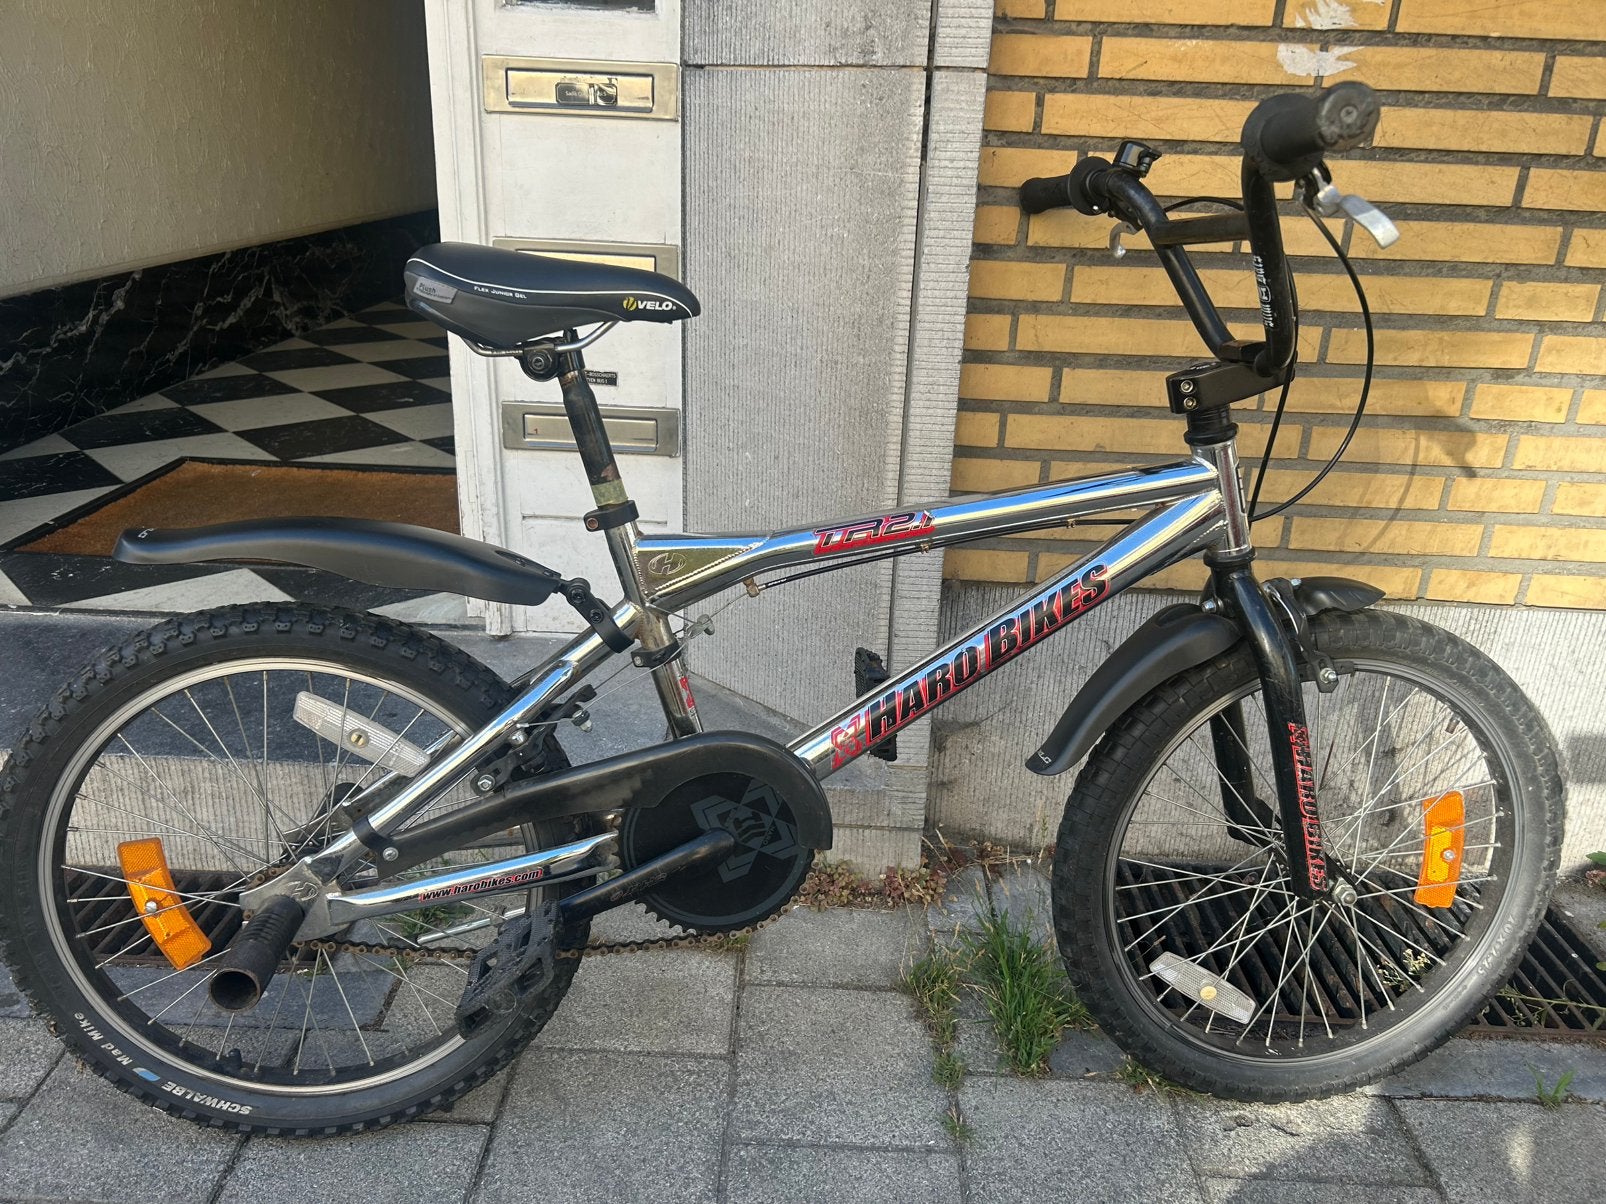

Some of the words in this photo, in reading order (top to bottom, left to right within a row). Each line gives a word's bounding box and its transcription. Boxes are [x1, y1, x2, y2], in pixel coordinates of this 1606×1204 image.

[490, 288, 513, 297] JUNIOR
[866, 645, 982, 745] HARO
[985, 562, 1111, 671] BIKES
[421, 869, 543, 901] www.harobikes.com
[74, 1012, 104, 1041] Mike
[101, 1042, 133, 1066] Mad
[161, 1081, 253, 1115] SCHWALBE
